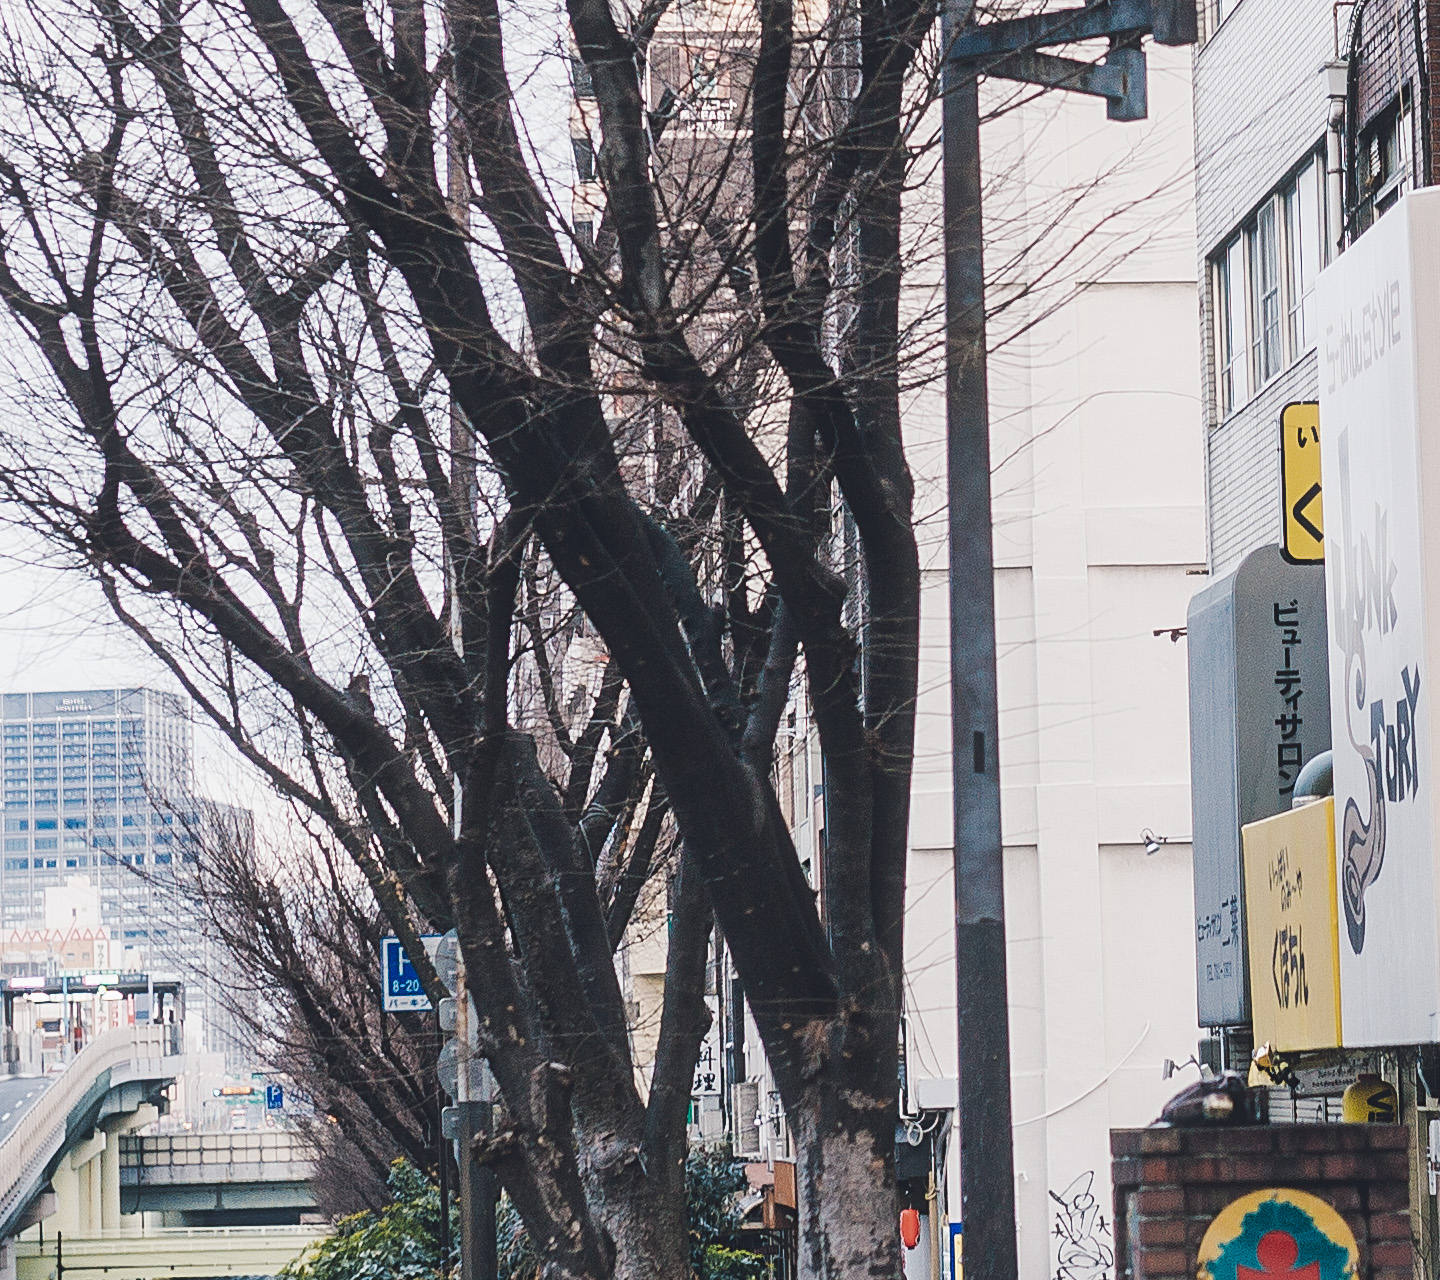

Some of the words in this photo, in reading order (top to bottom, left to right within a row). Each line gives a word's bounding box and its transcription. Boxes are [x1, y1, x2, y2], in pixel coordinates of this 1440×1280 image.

[1273, 598, 1303, 795] ビューティサロン
[392, 979, 420, 993] 8-20
